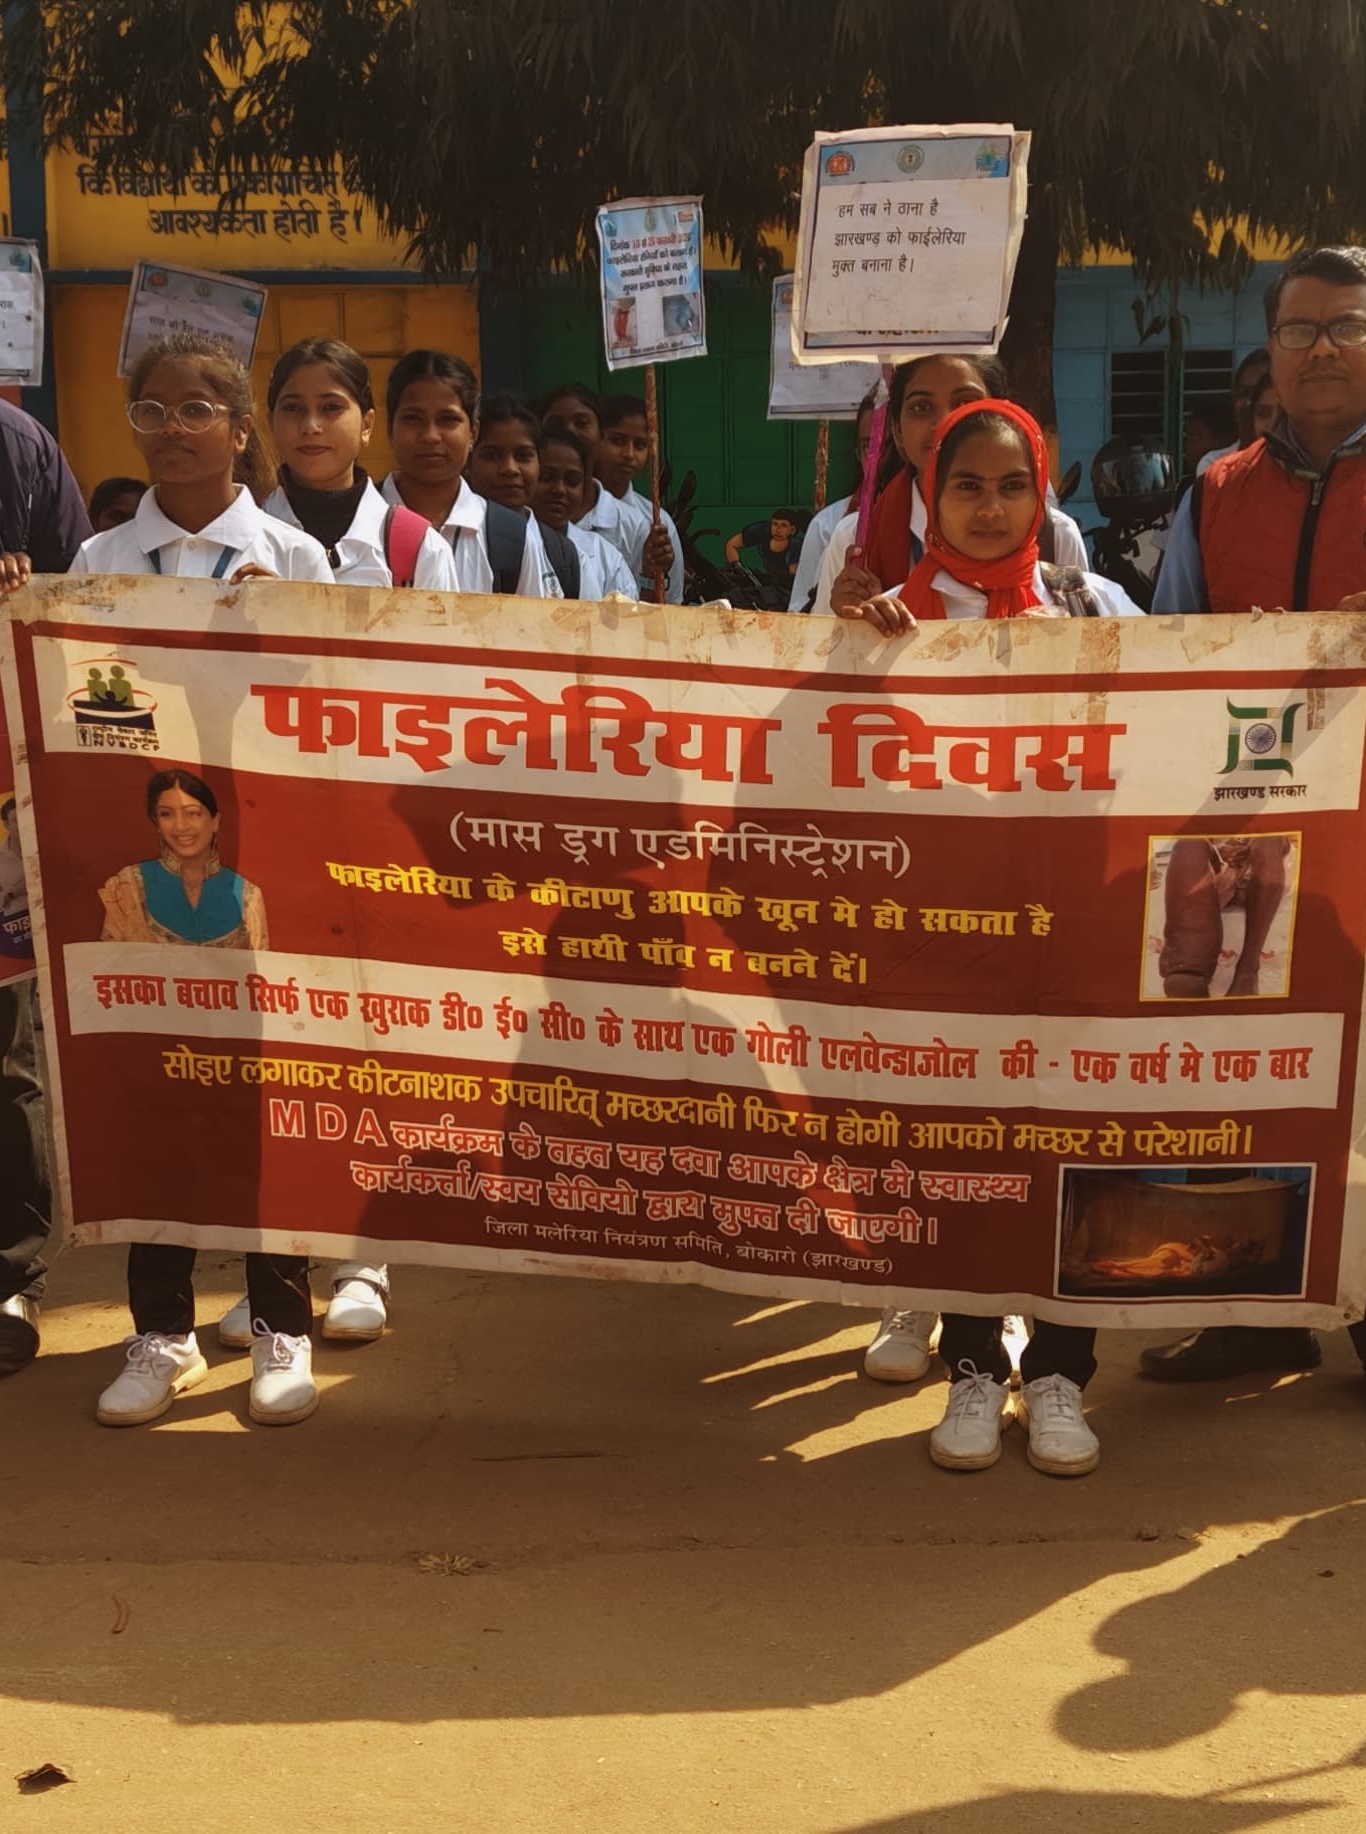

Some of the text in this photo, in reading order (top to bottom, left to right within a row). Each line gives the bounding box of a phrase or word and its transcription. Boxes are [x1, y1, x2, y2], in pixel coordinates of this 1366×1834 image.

[834, 226, 967, 248] झारखण्ड को फाईलेरिया
[838, 202, 853, 218] हम
[859, 202, 877, 217] सब
[883, 198, 892, 215] ने
[898, 200, 923, 216] ठाना
[832, 258, 855, 278] मुक्त
[861, 257, 892, 272] बनाना
[251, 678, 1127, 793] फाइलेरिया दिवस
[1213, 784, 1307, 801] झारखण्ड सरकार
[450, 811, 911, 880] (मास ड्रग एडमिनिस्ट्रेशन)
[326, 861, 1054, 937] फाइलेरिया के कीटाणु आपके खून मे हो सकता है
[498, 927, 548, 957] इसे
[557, 933, 629, 962] हाथी
[705, 947, 733, 972] न
[744, 948, 819, 978] बनने
[93, 974, 166, 1009] इसका
[173, 977, 238, 1011] बचाव
[246, 973, 299, 1014] सिर्फ
[306, 988, 350, 1019] एक
[357, 992, 431, 1035] खुराक
[595, 1008, 623, 1048] के
[632, 1018, 685, 1053] साथ
[691, 1023, 737, 1058] एक
[745, 1020, 811, 1067] गोली
[820, 1031, 979, 1080] एलवेन्डाजोल
[999, 1039, 1038, 1080] की
[1071, 1049, 1123, 1085] एक
[1129, 1043, 1171, 1085] वर्ष
[1178, 1042, 1203, 1084] मे
[1212, 1047, 1262, 1084] एक
[1269, 1047, 1313, 1081] बार
[162, 1043, 233, 1086] सोइए
[238, 1055, 343, 1091] लगाकर
[346, 1058, 483, 1104] कीटनाशक
[605, 1088, 737, 1131] मच्छरदानी
[744, 1096, 798, 1138] फिर
[801, 1111, 829, 1142] न
[837, 1110, 901, 1149] होगी
[908, 1116, 1006, 1152] आपको
[1013, 1123, 1093, 1157] मच्छर
[1098, 1120, 1125, 1157] से
[391, 1114, 504, 1157] कार्यक्रम
[509, 1121, 541, 1160] के
[547, 1135, 612, 1169] तहत
[617, 1143, 665, 1176] यह
[671, 1145, 721, 1178] दवा
[728, 1150, 818, 1191] आपके
[823, 1154, 877, 1199] क्षेत्र
[881, 1160, 914, 1199] मे
[919, 1170, 1032, 1203] स्वास्थ्य
[642, 1187, 705, 1222] द्वारा
[711, 1195, 781, 1236] मुफ्त
[787, 1197, 819, 1236] दी
[484, 1216, 530, 1236] जिला
[533, 1221, 599, 1245] मलेरिया
[603, 1226, 667, 1250] नियंत्रण
[736, 1243, 797, 1265] बोकारो
[803, 1249, 894, 1275] (झारखण्ड)
